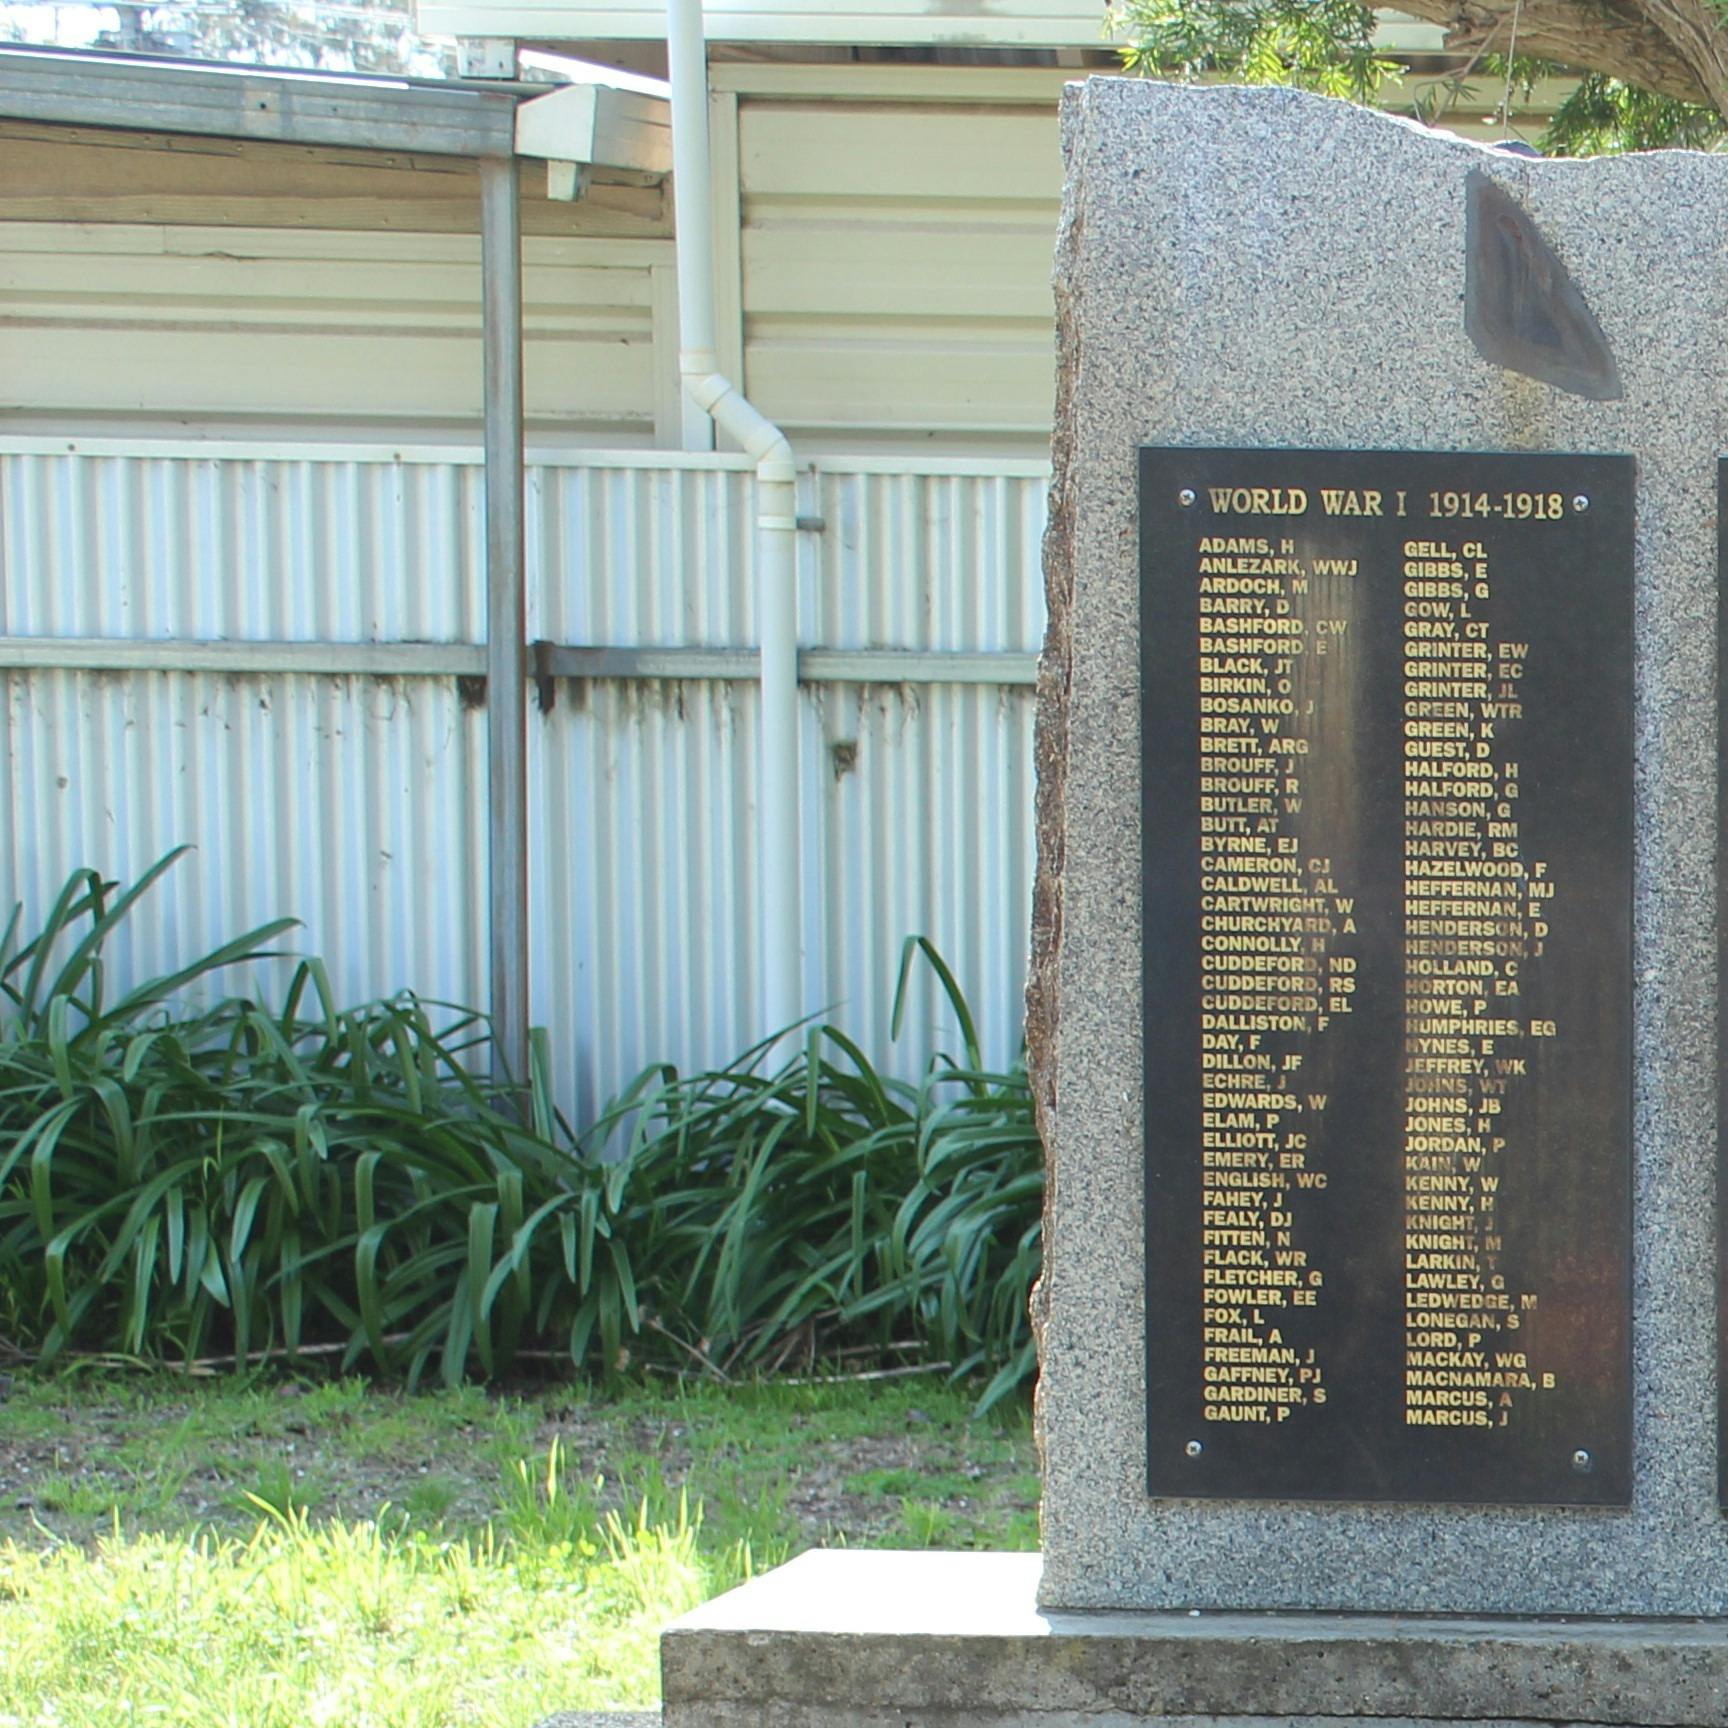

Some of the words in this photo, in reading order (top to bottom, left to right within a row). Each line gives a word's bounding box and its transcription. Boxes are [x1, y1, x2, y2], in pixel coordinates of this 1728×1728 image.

[1210, 489, 1307, 514] WORLD
[1321, 490, 1382, 515] WAR
[1397, 492, 1406, 516] I
[1431, 492, 1563, 519] 1914-1918
[1199, 538, 1274, 556] ADAMS,
[1281, 539, 1294, 554] H
[1404, 541, 1456, 560] GELL,
[1463, 543, 1487, 558] CL
[1200, 658, 1268, 676] BLACK,
[1275, 659, 1293, 674] JT
[1405, 741, 1470, 760] GUEST,
[1477, 743, 1490, 757] D
[1202, 837, 1271, 855] BYRNE,
[1278, 838, 1298, 853] EJ
[1405, 880, 1523, 899] HEFFERNAN,
[1529, 882, 1554, 897] MJ
[1203, 1053, 1275, 1072] DILLON,
[1283, 1055, 1302, 1070] JF
[1405, 1097, 1473, 1117] JOHNS,
[1479, 1098, 1501, 1113] JB
[1204, 1289, 1287, 1307] FOWLER,
[1293, 1290, 1316, 1305] EE
[1407, 1352, 1489, 1369] MACKAY,
[1496, 1353, 1526, 1368] WG
